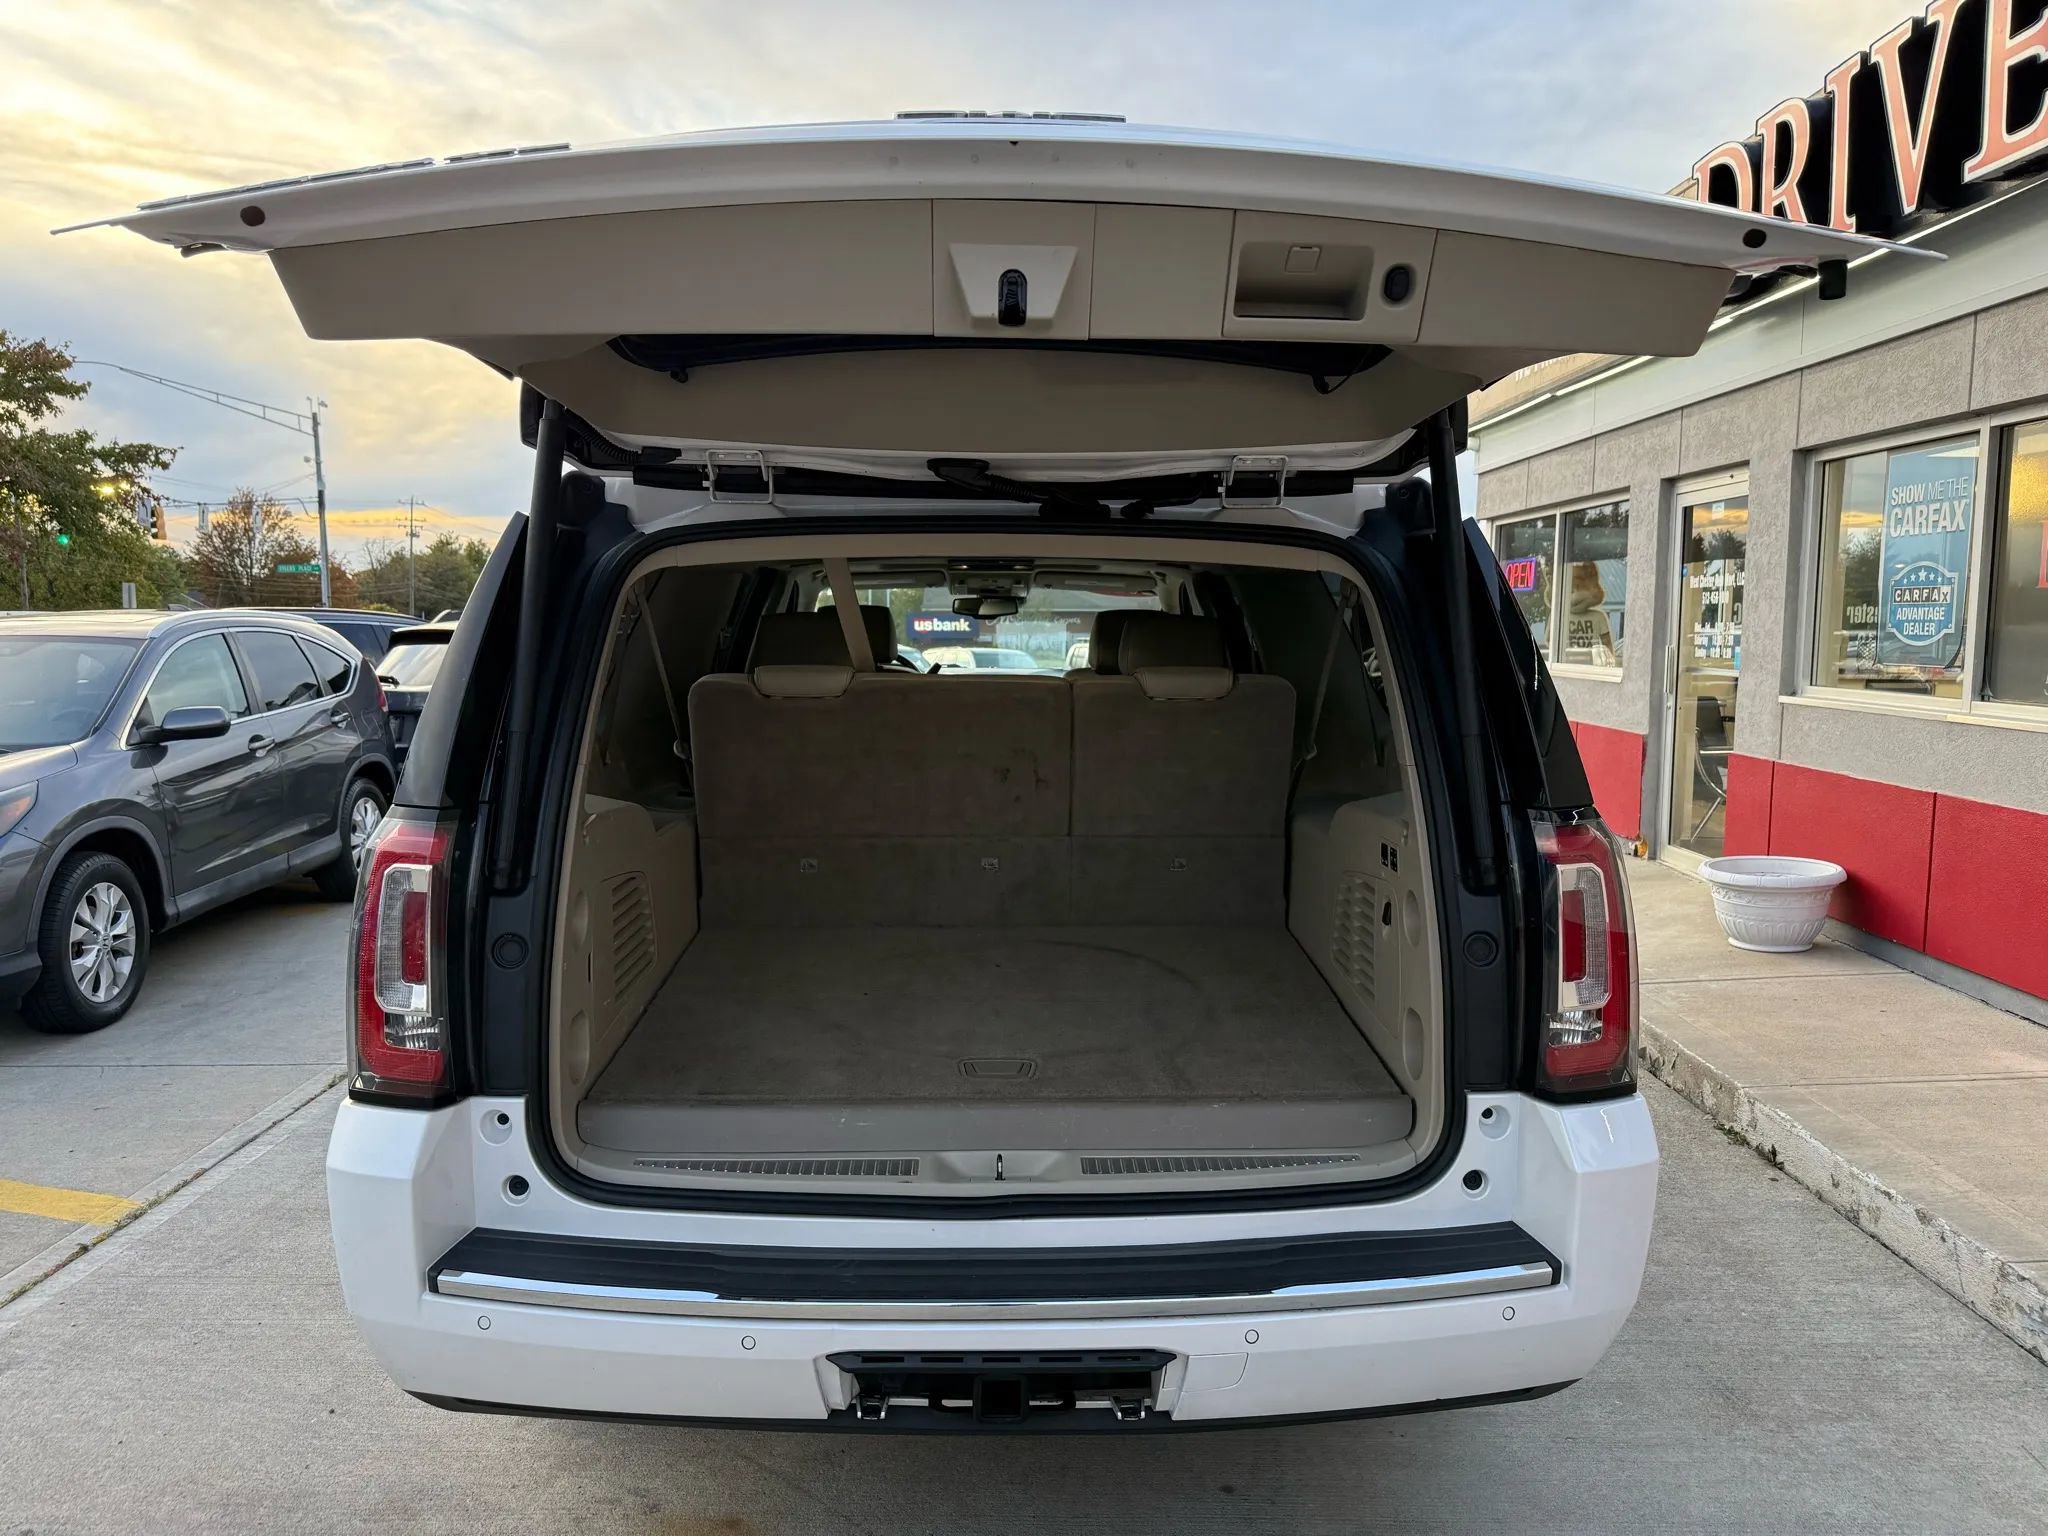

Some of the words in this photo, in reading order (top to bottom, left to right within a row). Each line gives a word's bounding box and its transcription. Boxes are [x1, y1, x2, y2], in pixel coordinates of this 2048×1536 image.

[1891, 484, 1925, 506] SHOW
[1928, 480, 1944, 500] ME
[1947, 476, 1968, 498] THE
[1890, 499, 1969, 538] CARFAX
[1506, 561, 1534, 588] OPEN
[1894, 587, 1950, 603] CARFAX
[1896, 606, 1945, 620] ADVANTAGE
[913, 617, 971, 632] usbank
[1569, 620, 1593, 635] CAR
[1904, 622, 1936, 636] DEALER
[1569, 635, 1593, 648] FOX
